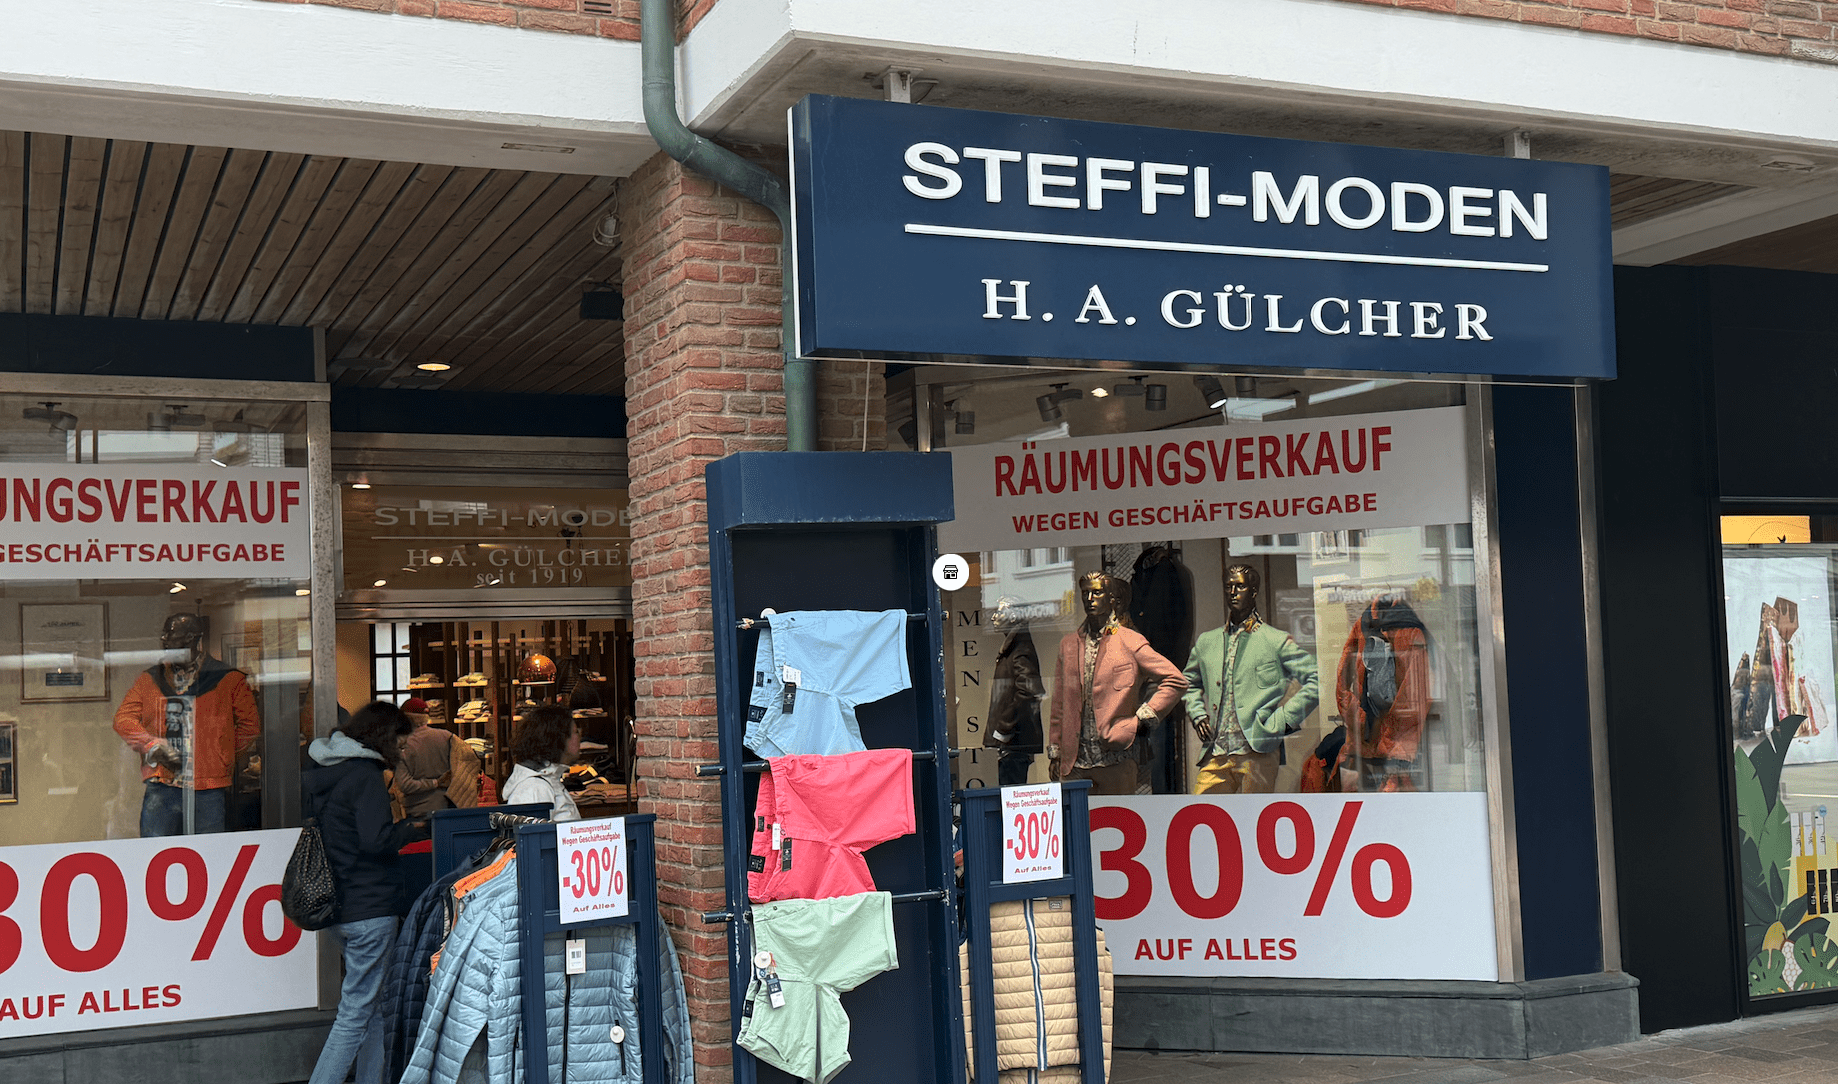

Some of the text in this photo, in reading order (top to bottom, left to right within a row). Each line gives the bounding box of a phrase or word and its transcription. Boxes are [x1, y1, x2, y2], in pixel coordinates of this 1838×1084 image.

[901, 142, 1549, 241] STEFFI-MODEN
[981, 278, 1494, 342] H. A. GÜLCHER
[994, 426, 1392, 498] RÄUMUNGSVERKAUF
[0, 477, 300, 524] NGSVERKAUF
[1012, 493, 1378, 534] WEGEN GESCHÄFTSAUFGABE
[447, 549, 477, 567] A.
[488, 545, 632, 568] GÜLCHE
[476, 568, 584, 585] seit 1919
[1007, 810, 1059, 860] -30%
[563, 845, 623, 899] -30%
[1031, 865, 1052, 873] Alles
[0, 844, 302, 977] 0%
[573, 903, 616, 913] Auf Alles
[1134, 937, 1298, 962] AUF ALLES
[0, 984, 182, 1021] AUF ALLES
